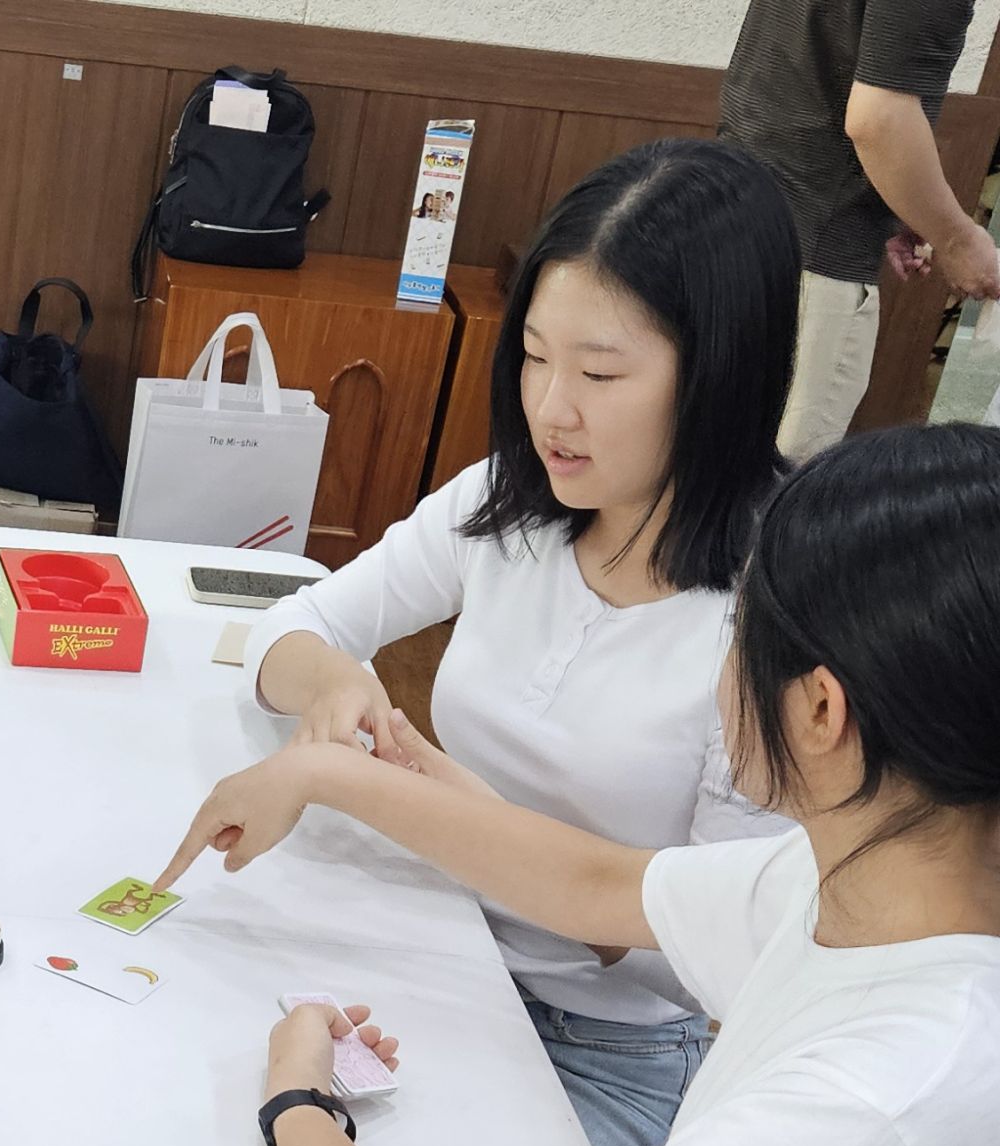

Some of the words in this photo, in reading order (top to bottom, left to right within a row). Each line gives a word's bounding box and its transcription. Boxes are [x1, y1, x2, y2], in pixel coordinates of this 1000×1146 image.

[210, 436, 225, 446] The
[226, 437, 259, 448] Mi-shik
[49, 624, 83, 634] HALLI
[85, 625, 119, 636] GALLI
